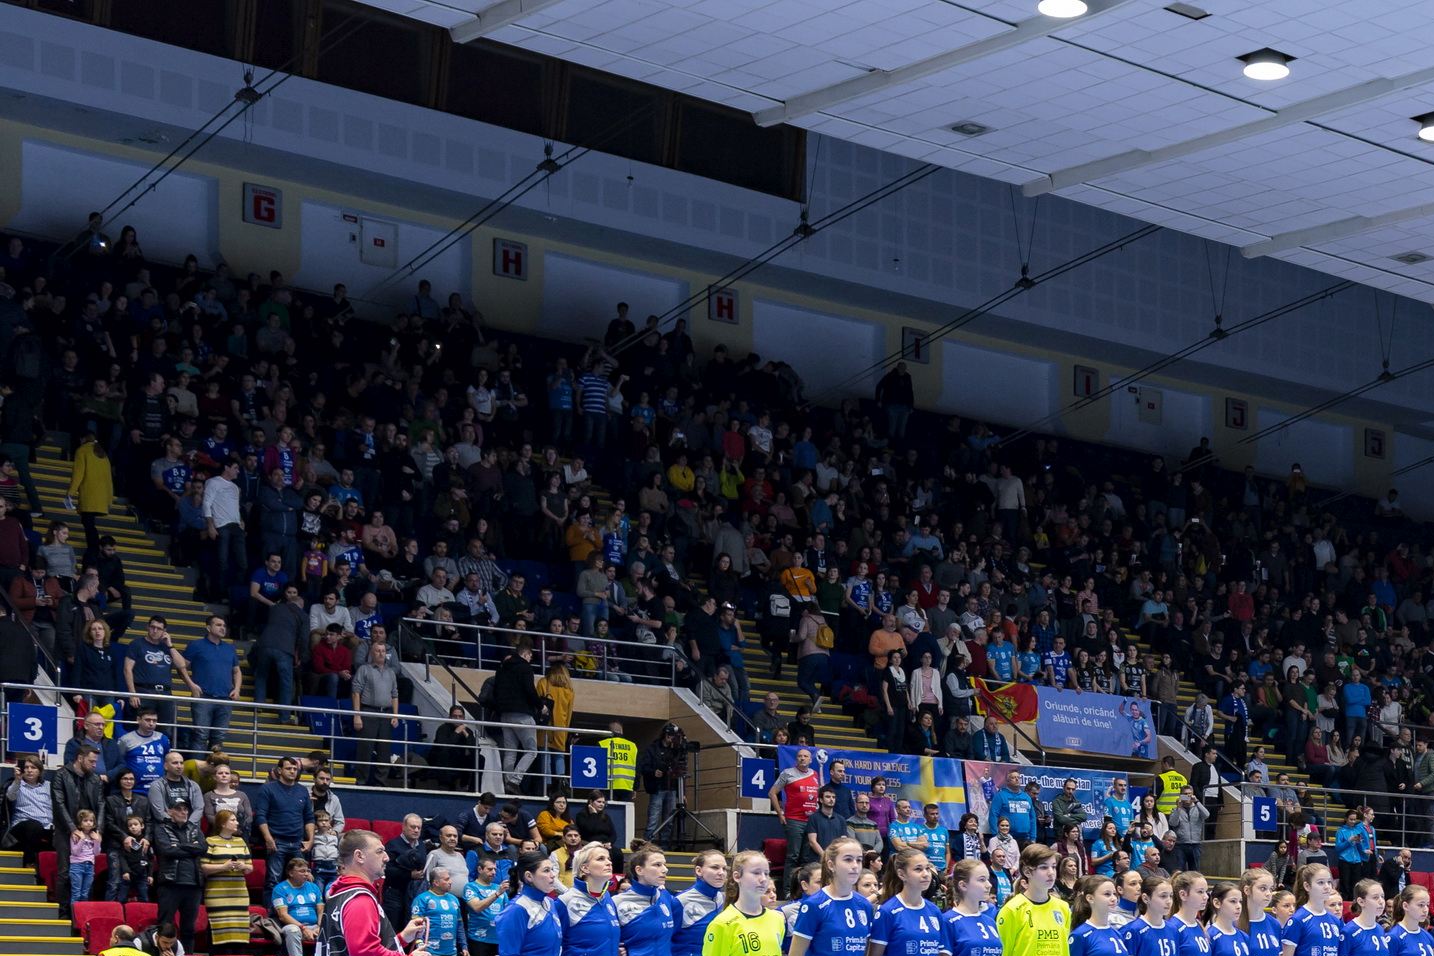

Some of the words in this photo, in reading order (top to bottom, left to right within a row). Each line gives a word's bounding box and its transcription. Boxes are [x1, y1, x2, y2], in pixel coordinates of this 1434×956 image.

[253, 195, 275, 223] G
[502, 249, 522, 276] H
[717, 297, 734, 320] H
[1233, 407, 1244, 427] J
[1044, 700, 1081, 715] Oriunde,
[24, 717, 43, 741] 3
[1081, 717, 1092, 727] de
[1094, 721, 1113, 729] tine!
[141, 744, 155, 755] 24
[582, 757, 597, 778] 3
[854, 760, 873, 770] HARD
[873, 762, 881, 770] IN
[882, 763, 911, 773] SILENCE.
[751, 769, 766, 790] 4
[1132, 796, 1142, 812] 4
[1260, 805, 1270, 821] 5
[844, 908, 856, 928] 8
[919, 916, 929, 933] 4
[1026, 910, 1034, 928] 1
[976, 922, 989, 940] 3
[1037, 929, 1060, 940] PMB
[1319, 922, 1332, 939] 13
[738, 932, 761, 954] 16
[1158, 938, 1171, 956] 15
[1194, 936, 1209, 953] 10
[1233, 940, 1242, 956] 6
[1256, 933, 1270, 950] 11
[1371, 935, 1380, 951] 9
